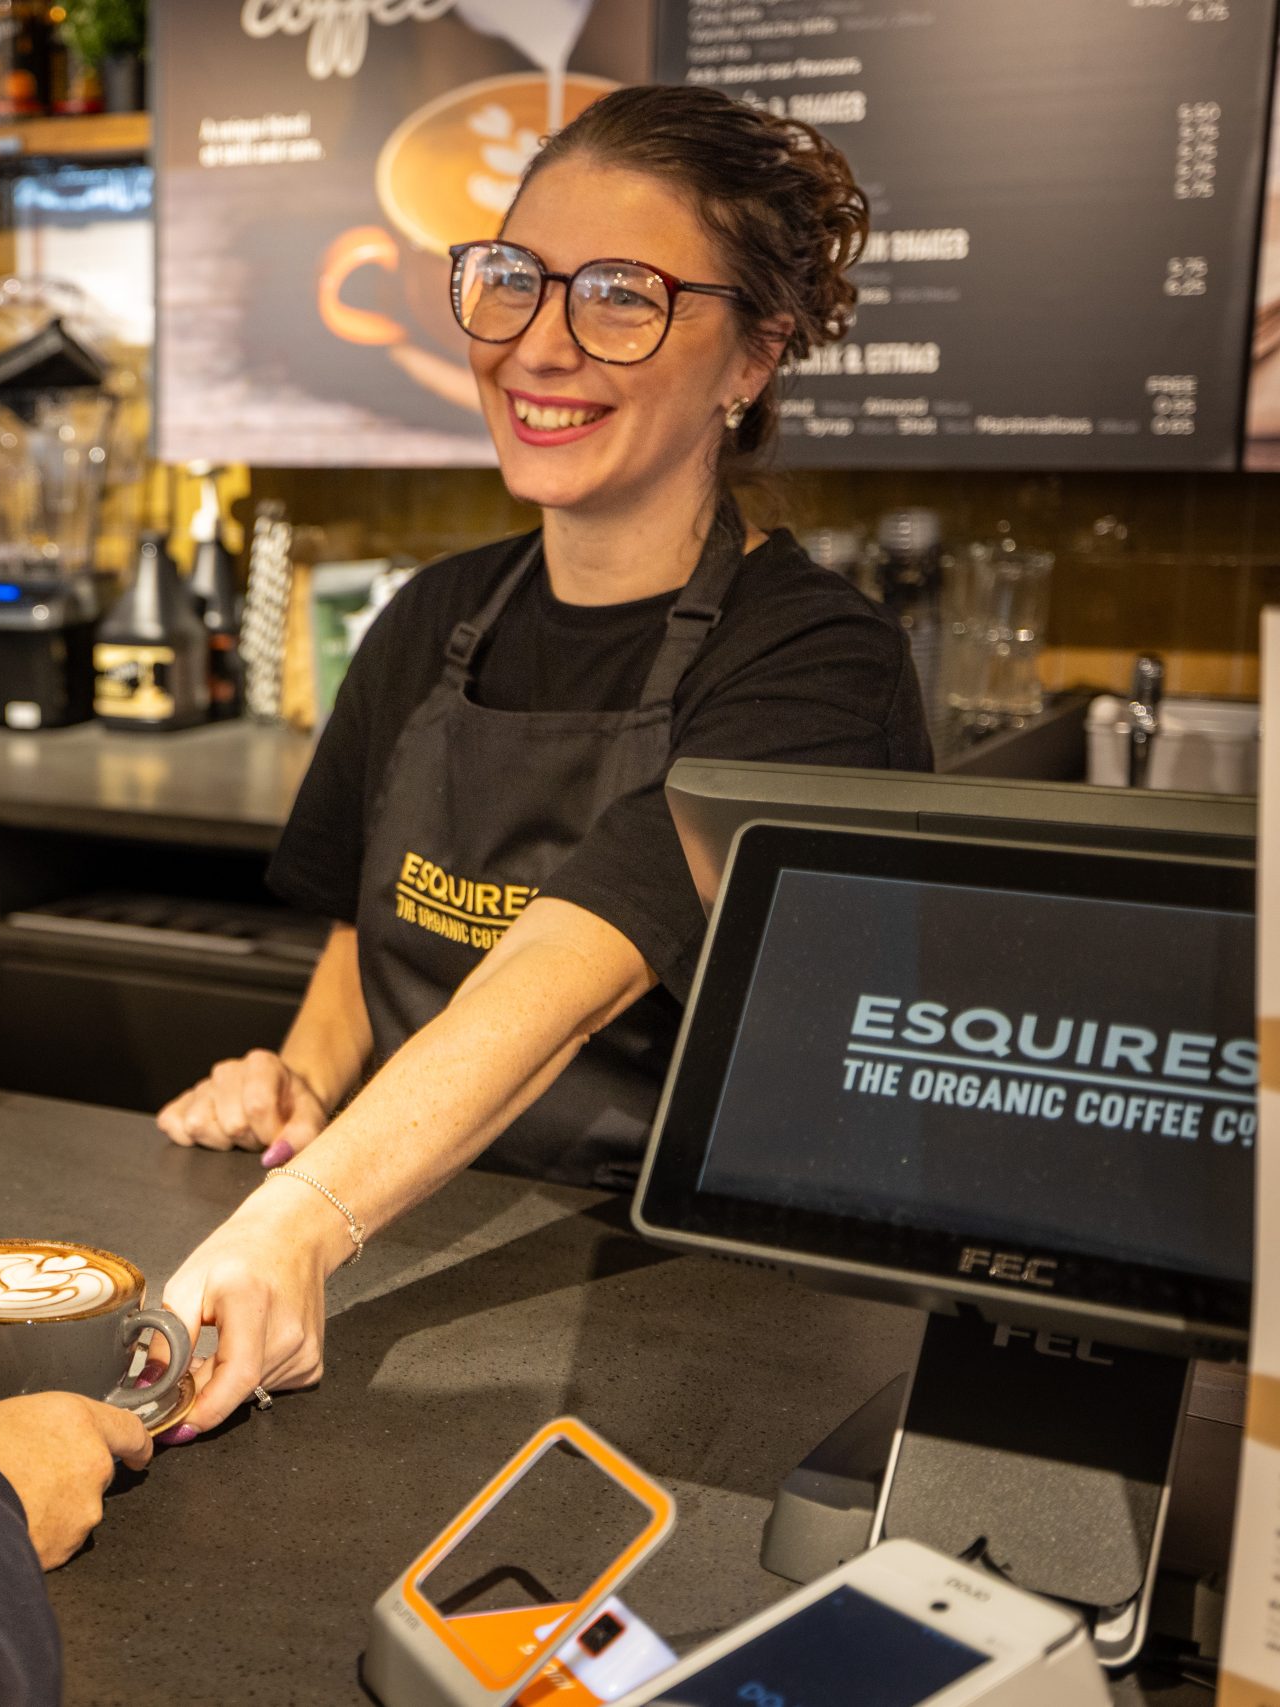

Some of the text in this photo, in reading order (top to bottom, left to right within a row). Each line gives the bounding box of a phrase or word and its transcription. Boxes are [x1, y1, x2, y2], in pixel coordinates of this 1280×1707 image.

[400, 851, 539, 917] ESQUIRE
[395, 892, 417, 924] THE
[417, 904, 469, 944] ORGANIC
[850, 994, 1259, 1086] ESQUIRES
[842, 1058, 903, 1097] THE
[909, 1068, 1067, 1120] ORGANIC
[1075, 1087, 1204, 1140] COFFEE
[958, 1247, 1059, 1288] FEC
